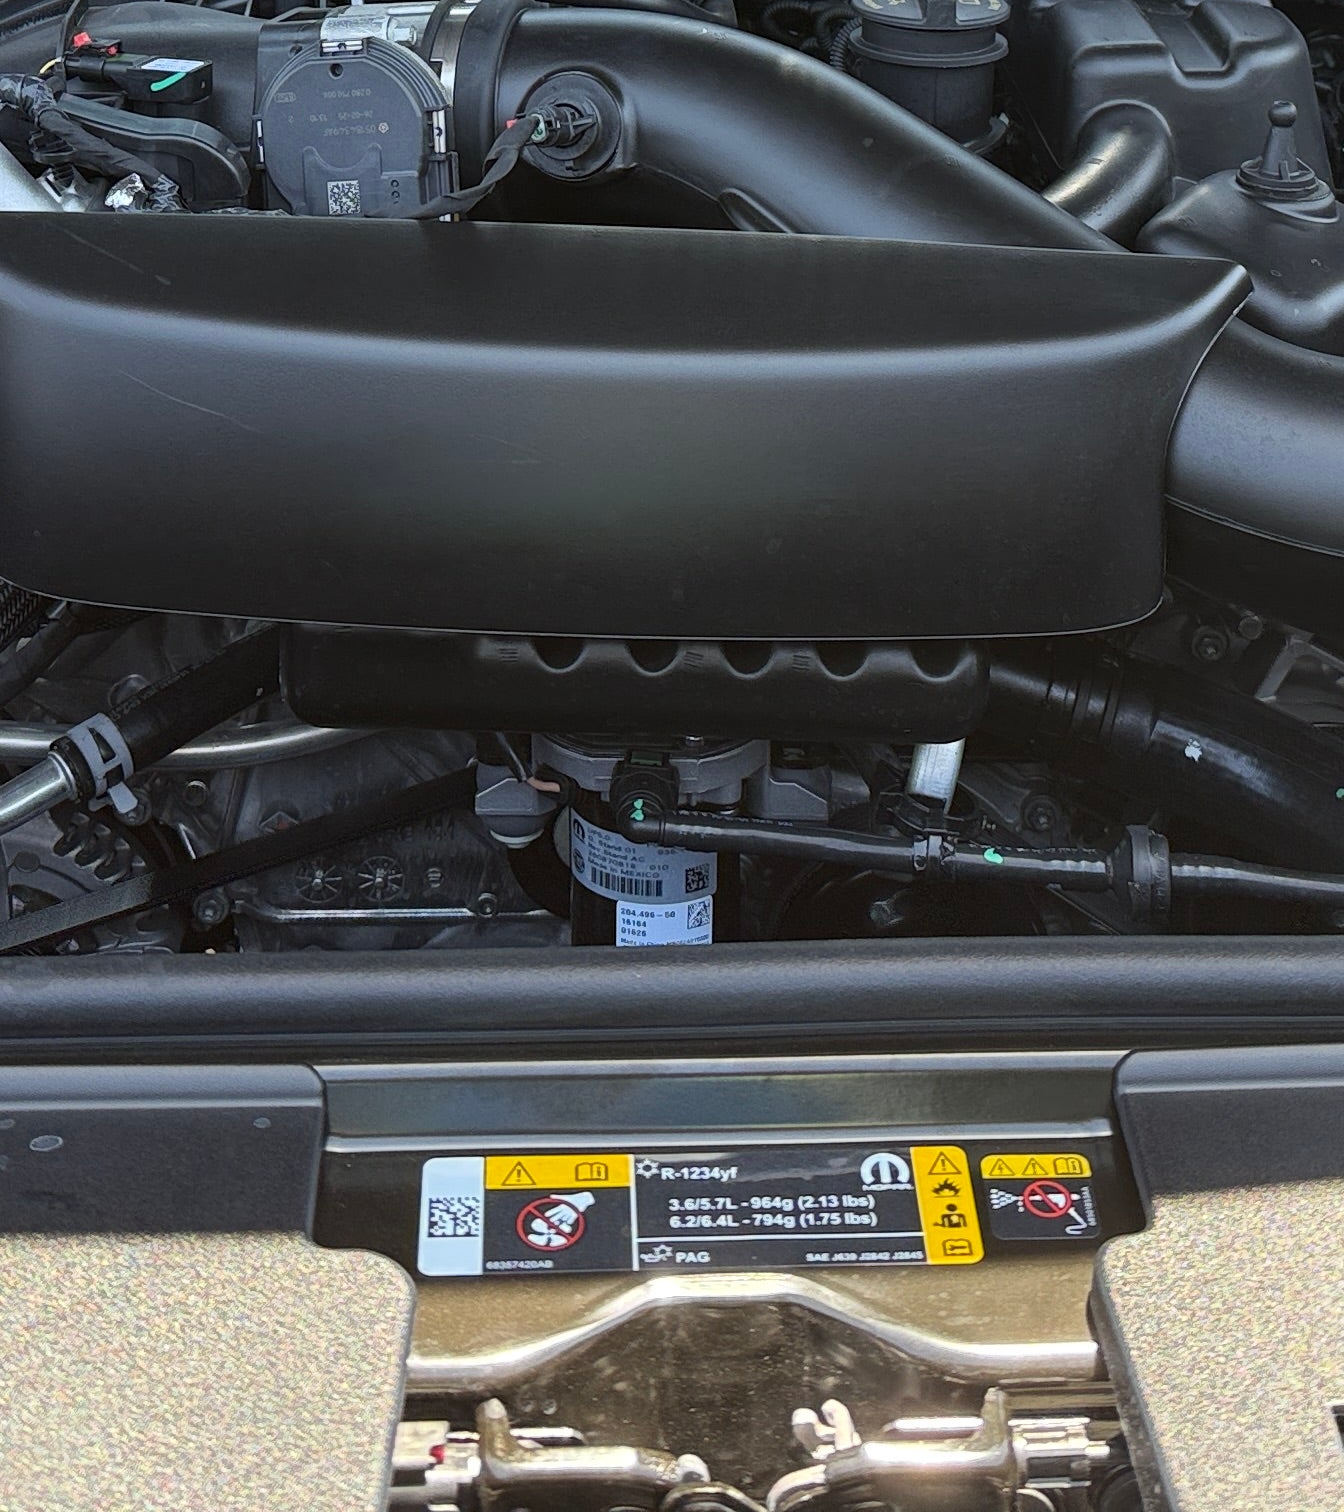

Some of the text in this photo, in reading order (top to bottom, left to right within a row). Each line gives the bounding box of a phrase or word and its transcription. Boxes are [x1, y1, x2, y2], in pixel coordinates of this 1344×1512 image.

[620, 868, 660, 879] MEXICO
[660, 1166, 738, 1182] R-1234yf
[668, 1198, 738, 1212] 3.6/5.7L
[750, 1198, 794, 1211] 964g
[798, 1195, 839, 1210] (2.13
[842, 1194, 875, 1209] lbs)
[669, 1214, 740, 1228] 6.2/6.4L
[753, 1213, 794, 1228] 794g
[800, 1212, 841, 1227] (1.75
[845, 1211, 878, 1227] lbs)
[675, 1252, 711, 1263] PAG
